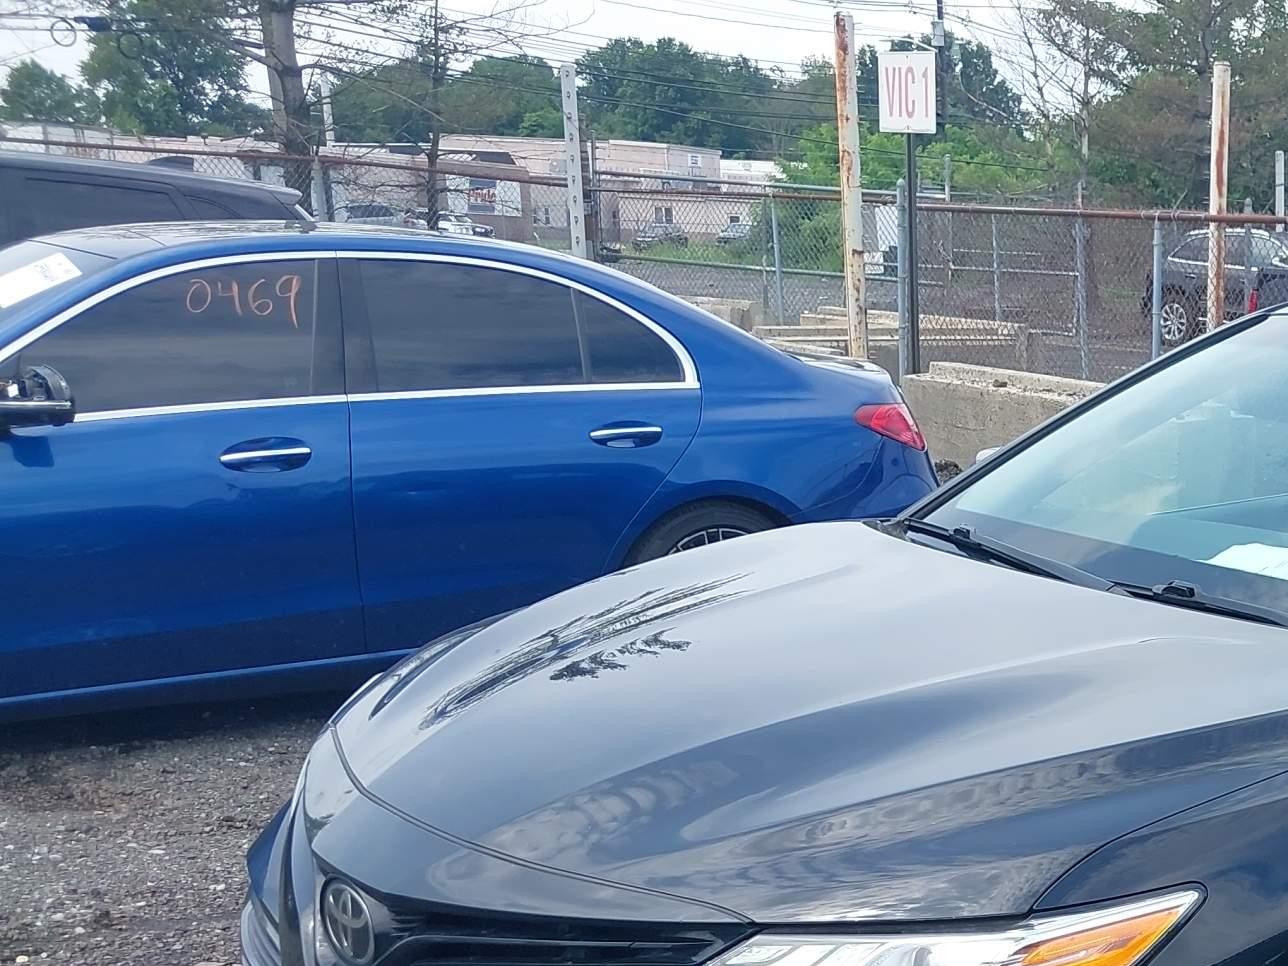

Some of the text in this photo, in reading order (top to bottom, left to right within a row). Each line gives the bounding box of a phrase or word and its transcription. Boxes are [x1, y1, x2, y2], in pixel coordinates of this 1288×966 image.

[885, 66, 929, 119] VIC 1
[186, 274, 301, 329] 0469
